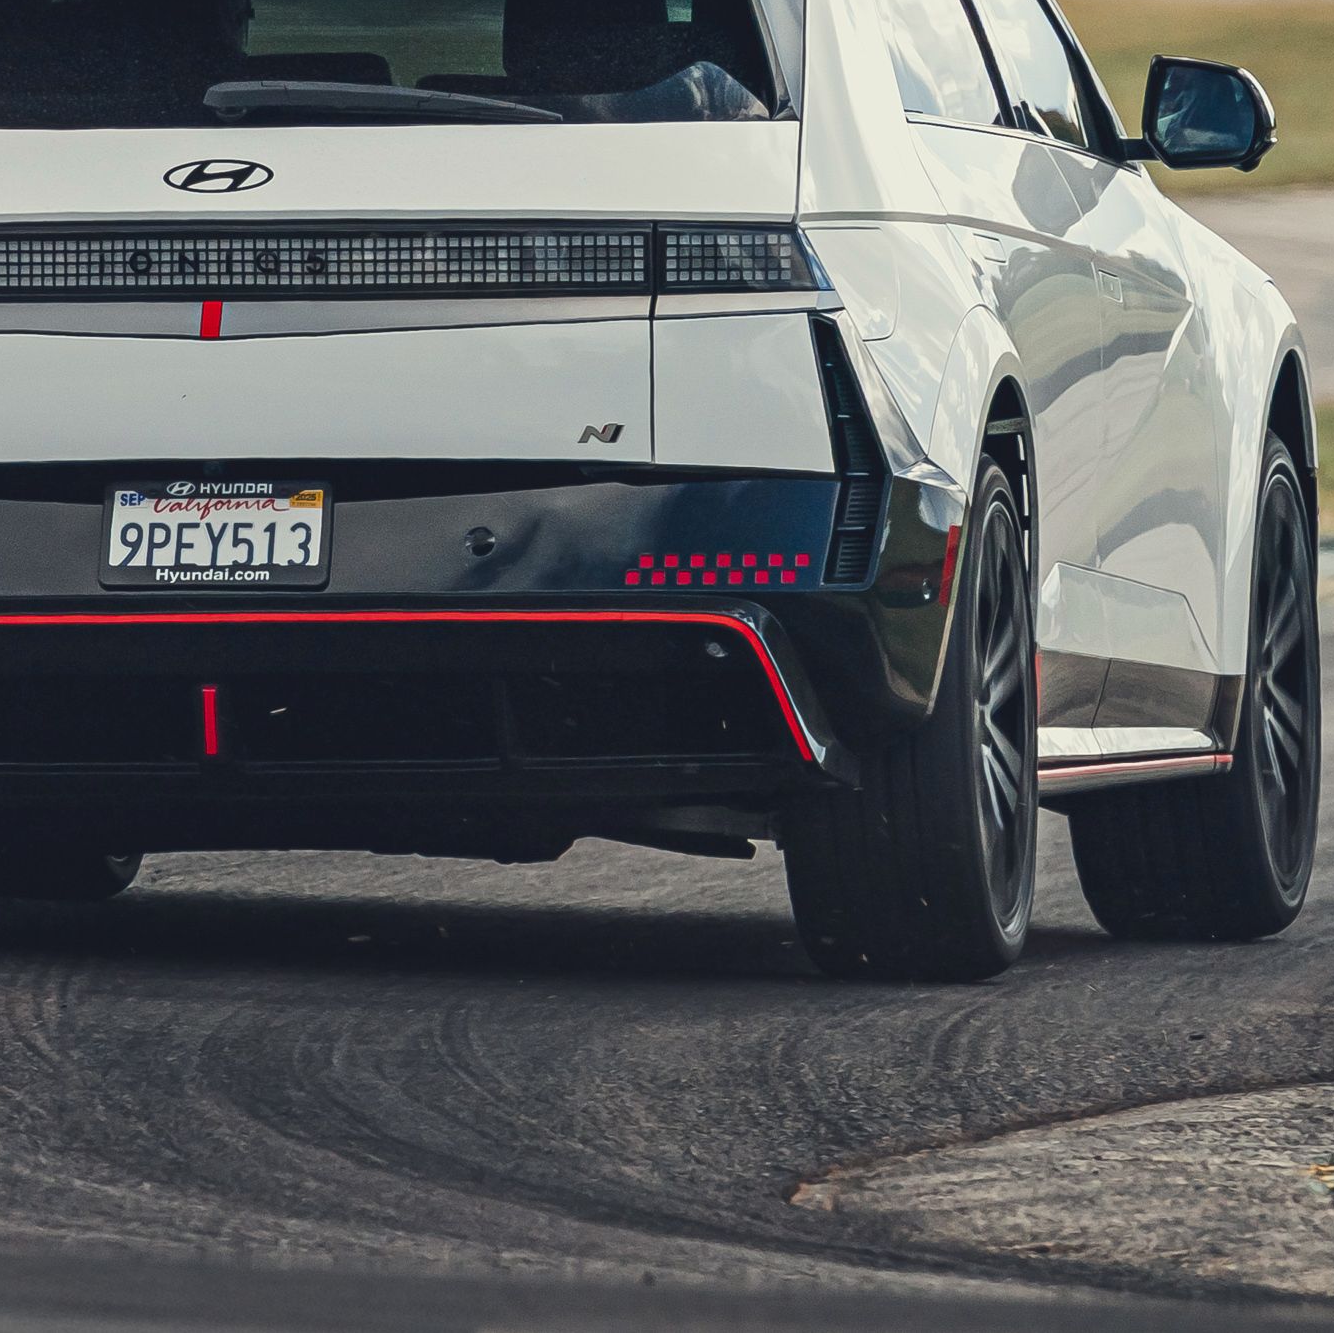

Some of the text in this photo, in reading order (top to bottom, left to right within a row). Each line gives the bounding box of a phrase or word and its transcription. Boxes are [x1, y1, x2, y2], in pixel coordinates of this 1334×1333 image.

[99, 250, 279, 275] IONIQ
[199, 482, 273, 495] HYUNDAI
[120, 493, 146, 507] SEP
[153, 497, 290, 520] California
[120, 522, 312, 566] 9PEY513
[155, 568, 270, 584] Hyundai.com
